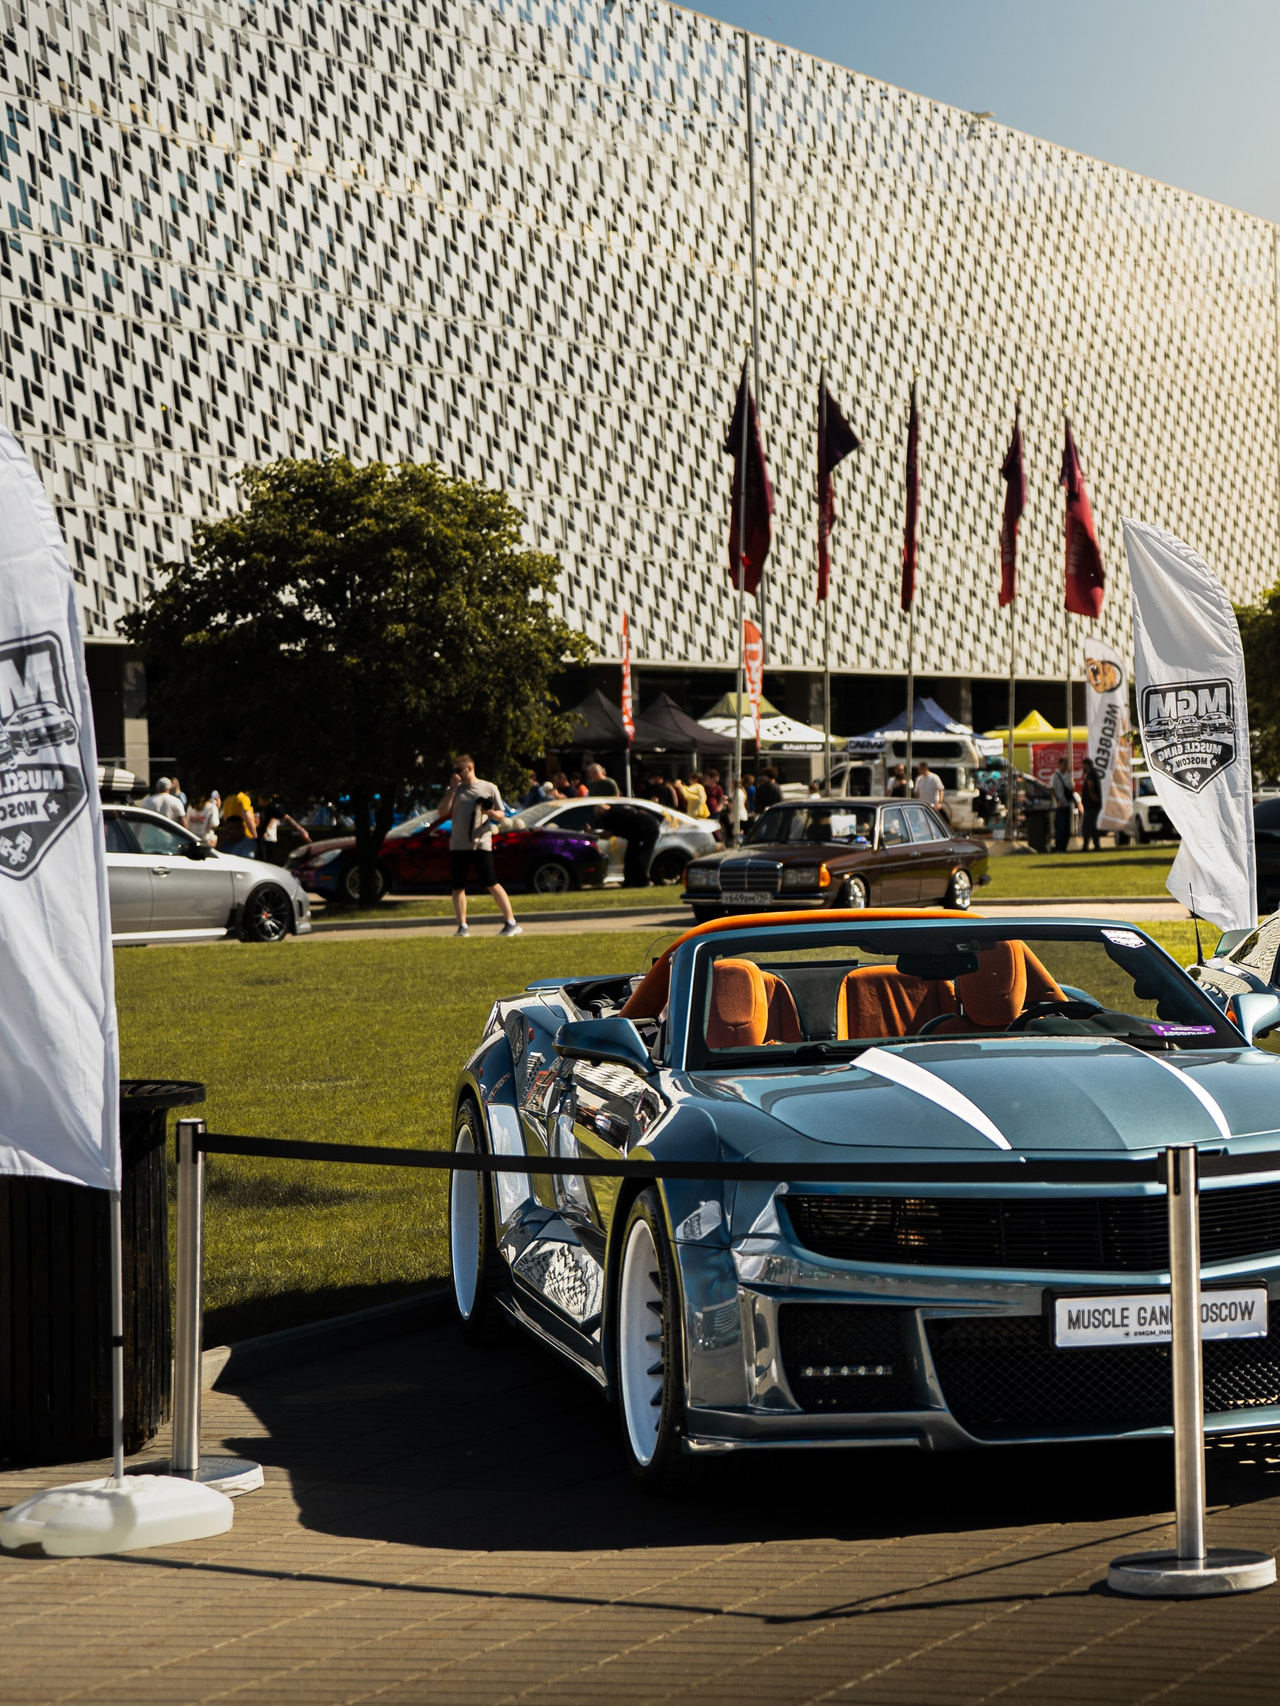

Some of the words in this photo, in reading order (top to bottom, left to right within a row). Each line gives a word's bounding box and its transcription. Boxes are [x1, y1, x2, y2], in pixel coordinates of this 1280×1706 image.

[1067, 1306, 1130, 1330] MUSCLE
[1137, 1304, 1173, 1327] GAN
[1201, 1300, 1256, 1324] OSCOW
[1133, 1329, 1173, 1337] @MGM_INS
